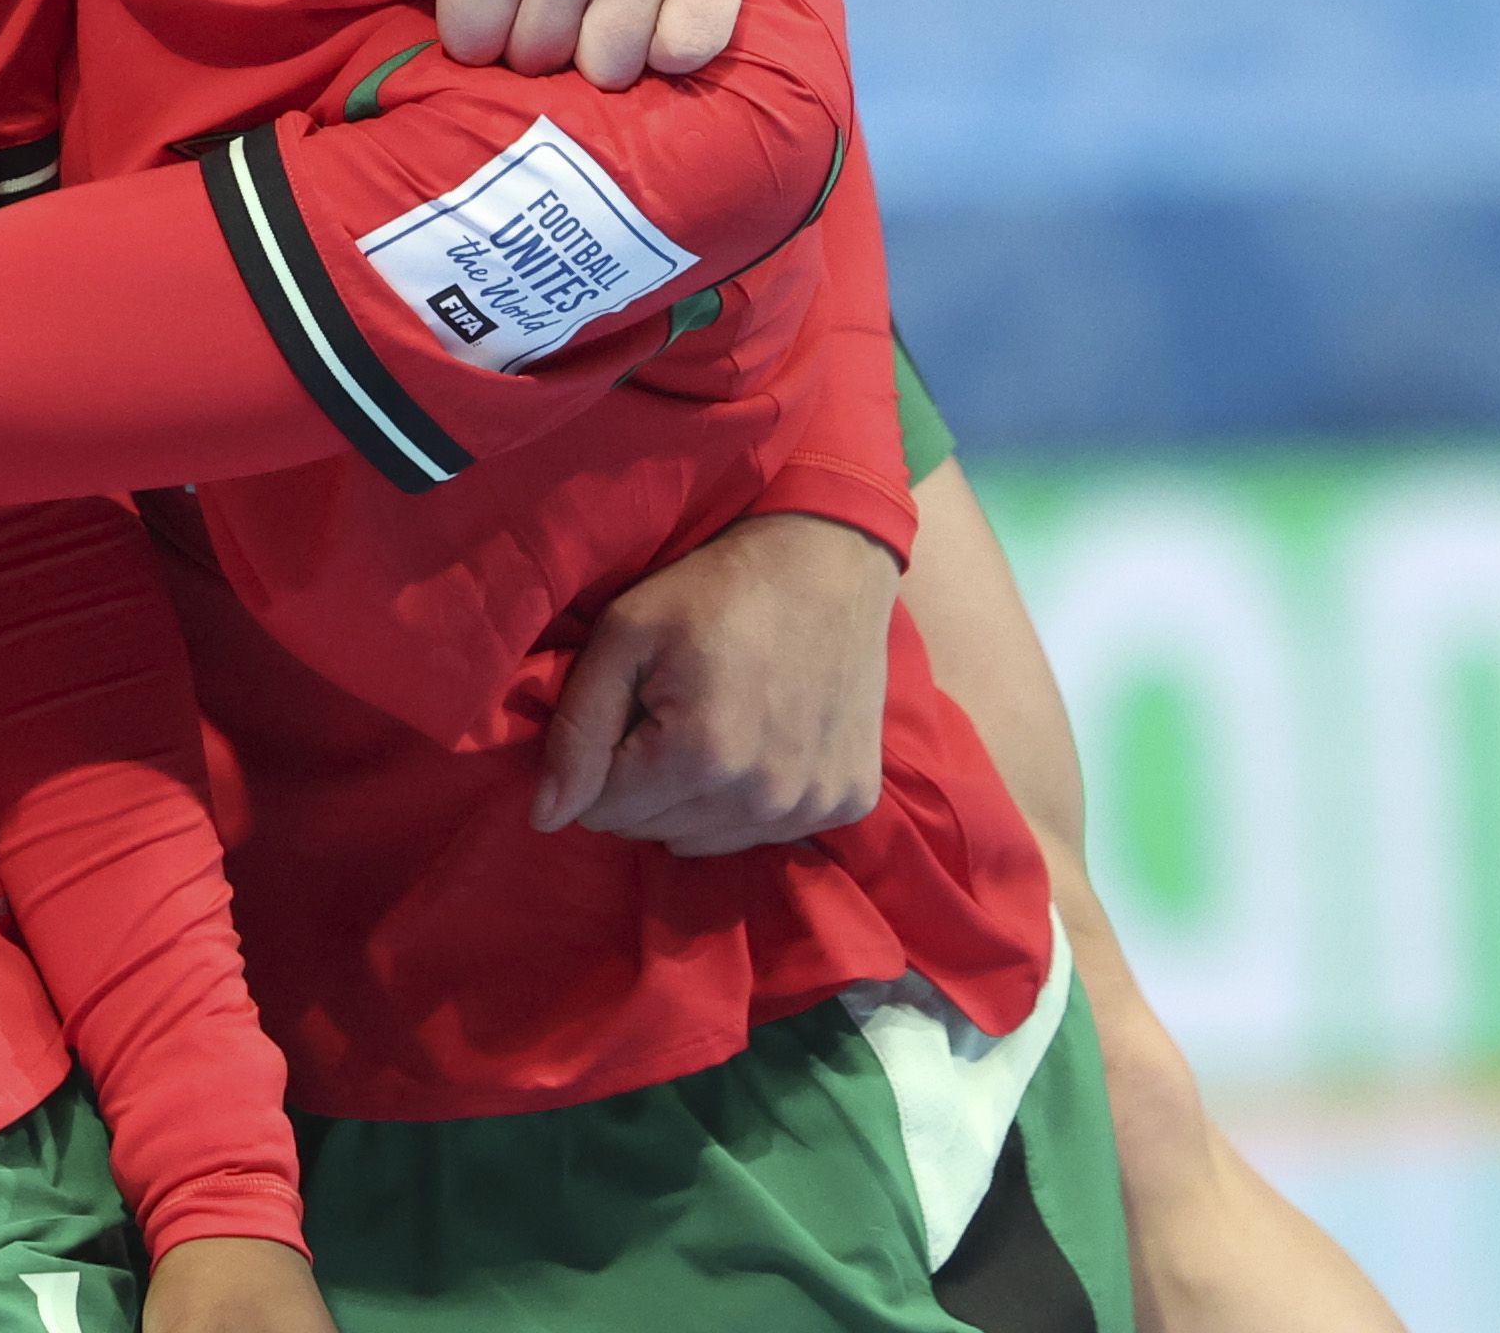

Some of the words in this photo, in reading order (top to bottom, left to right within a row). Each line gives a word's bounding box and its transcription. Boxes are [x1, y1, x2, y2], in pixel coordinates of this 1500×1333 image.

[446, 234, 491, 284] the
[480, 276, 563, 337] World
[489, 213, 599, 314] UNITES
[527, 188, 630, 292] FOOTBALL
[438, 293, 485, 337] FIFA
